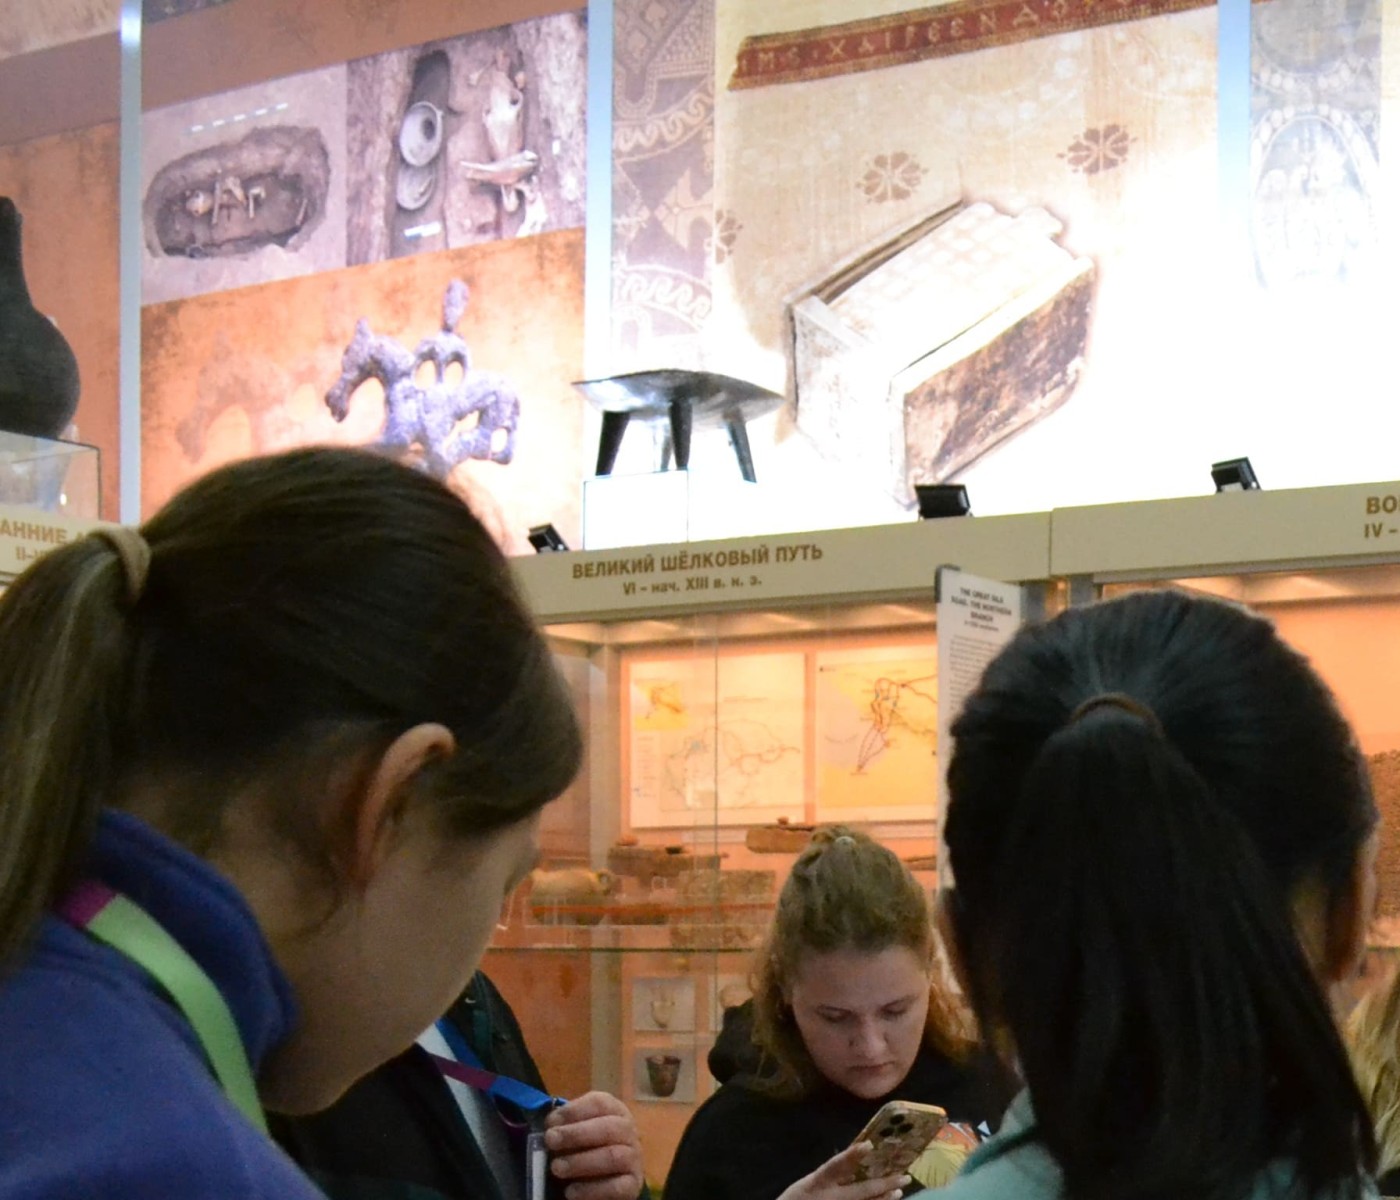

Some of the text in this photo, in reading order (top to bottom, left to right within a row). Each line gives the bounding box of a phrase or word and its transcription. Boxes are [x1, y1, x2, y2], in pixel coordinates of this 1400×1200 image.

[1364, 522, 1383, 538] IV
[572, 544, 823, 579] ВЕЛИКИЙ ШЁЛКОВЫЙ ПУТЬ
[651, 581, 680, 594] нач.
[685, 576, 709, 592] XIII
[713, 578, 726, 589] в.
[731, 577, 744, 588] н.
[750, 576, 762, 587] э.
